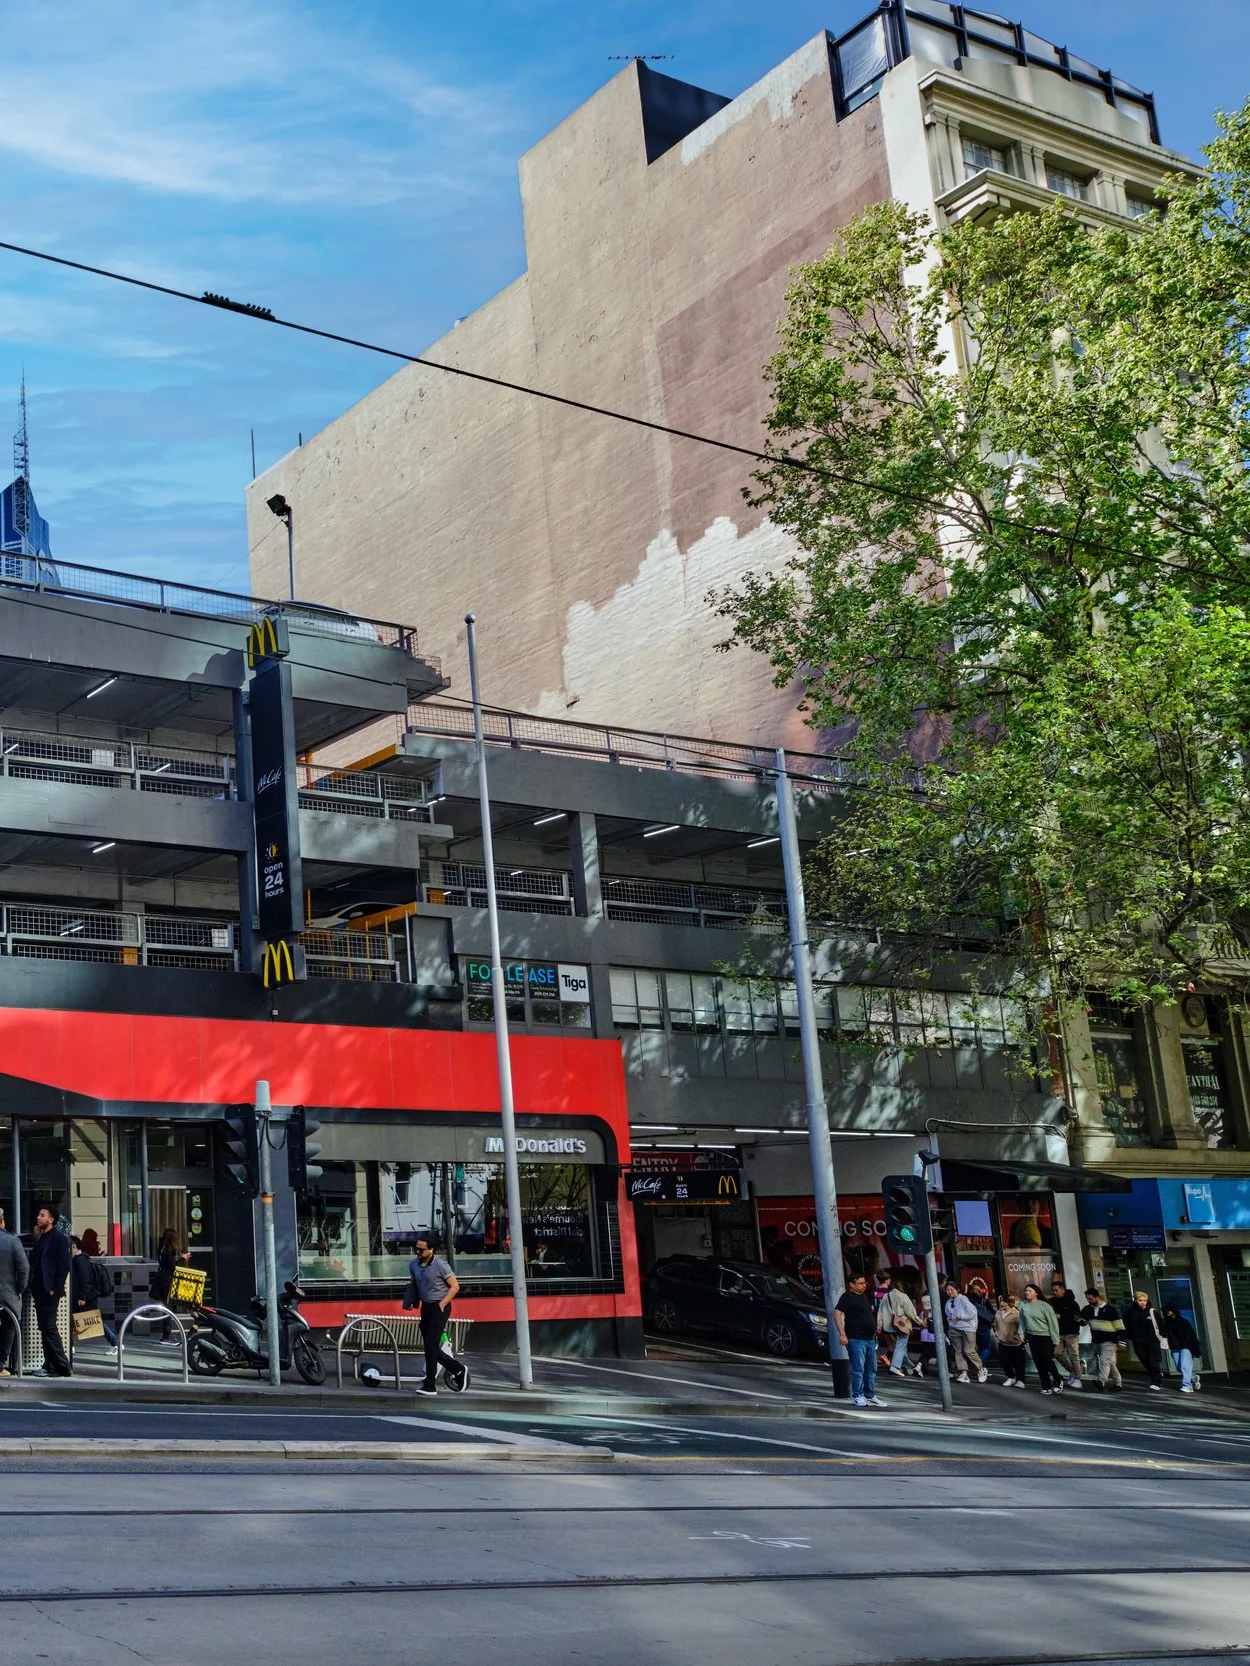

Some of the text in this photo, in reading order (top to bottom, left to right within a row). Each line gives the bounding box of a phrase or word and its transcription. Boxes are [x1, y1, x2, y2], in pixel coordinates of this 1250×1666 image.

[264, 861, 284, 874] open
[265, 874, 284, 890] 24
[265, 886, 284, 899] hours
[470, 964, 554, 984] FO LEASE
[562, 975, 586, 991] Tiga
[485, 1137, 586, 1153] MDonald's
[1186, 1187, 1201, 1195] Bupa
[785, 1220, 887, 1237] COG SO
[1008, 1263, 1056, 1272] COMING SOON
[83, 1316, 100, 1325] NIKE
